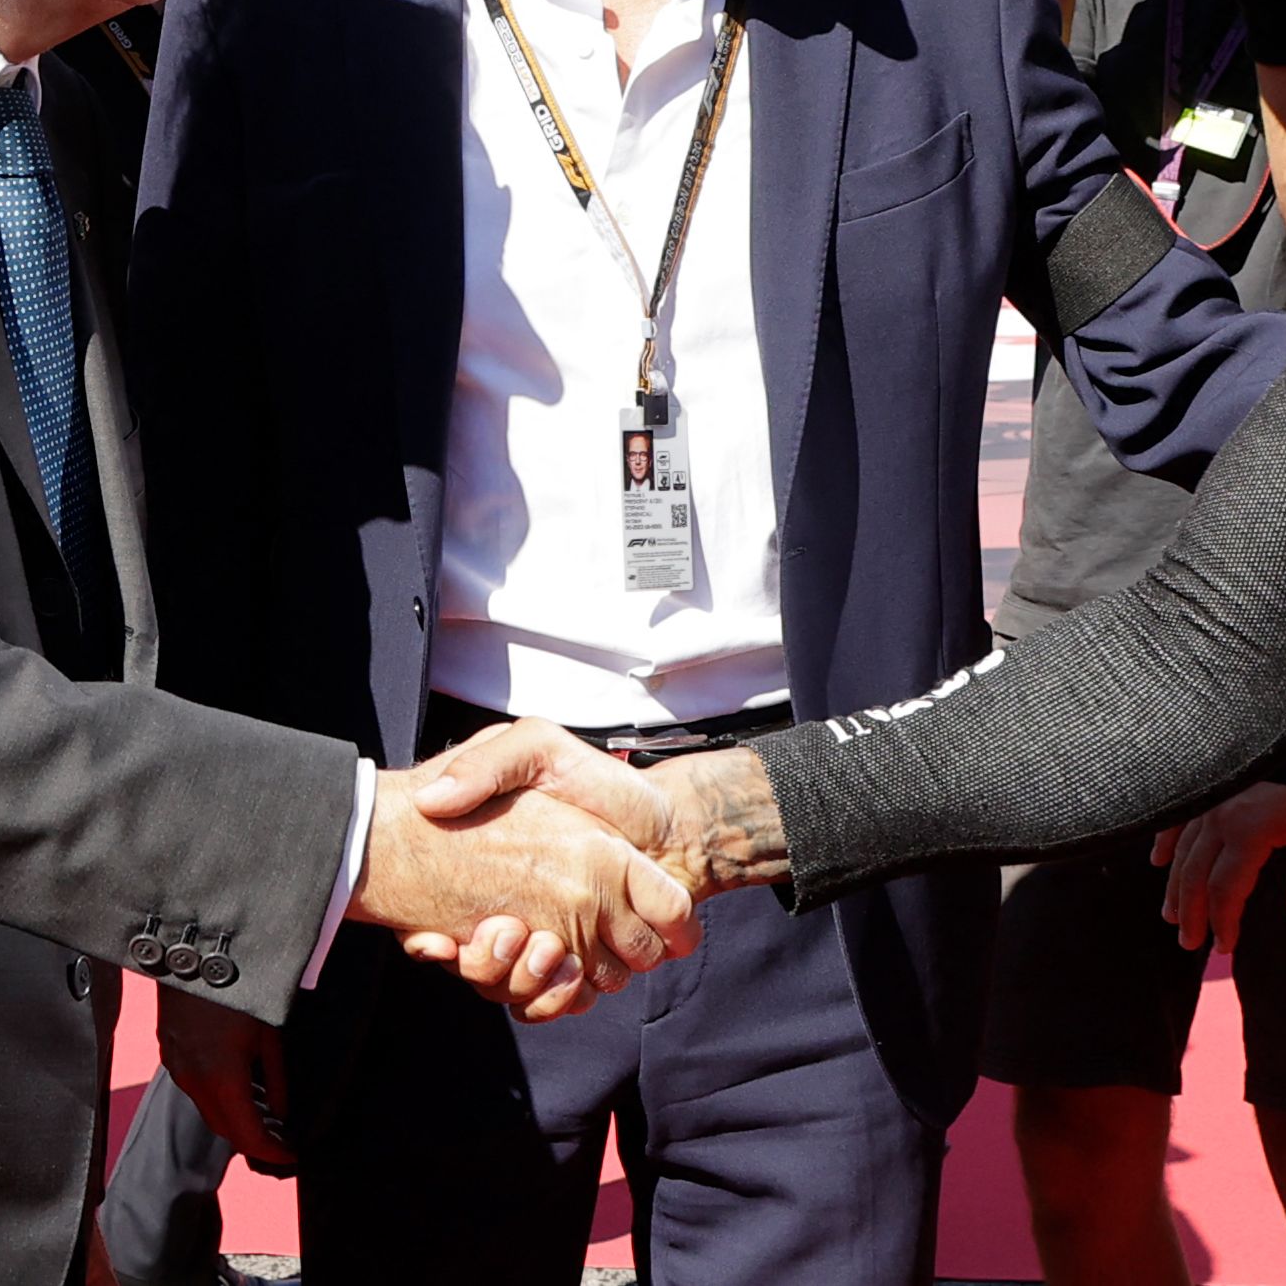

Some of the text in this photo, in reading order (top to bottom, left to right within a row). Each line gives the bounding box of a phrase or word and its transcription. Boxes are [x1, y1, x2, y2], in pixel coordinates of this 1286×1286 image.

[108, 21, 132, 49] GRID
[534, 104, 565, 152] GRID
[687, 140, 702, 172] 2030
[683, 170, 694, 189] BY
[671, 188, 690, 239] CARBON
